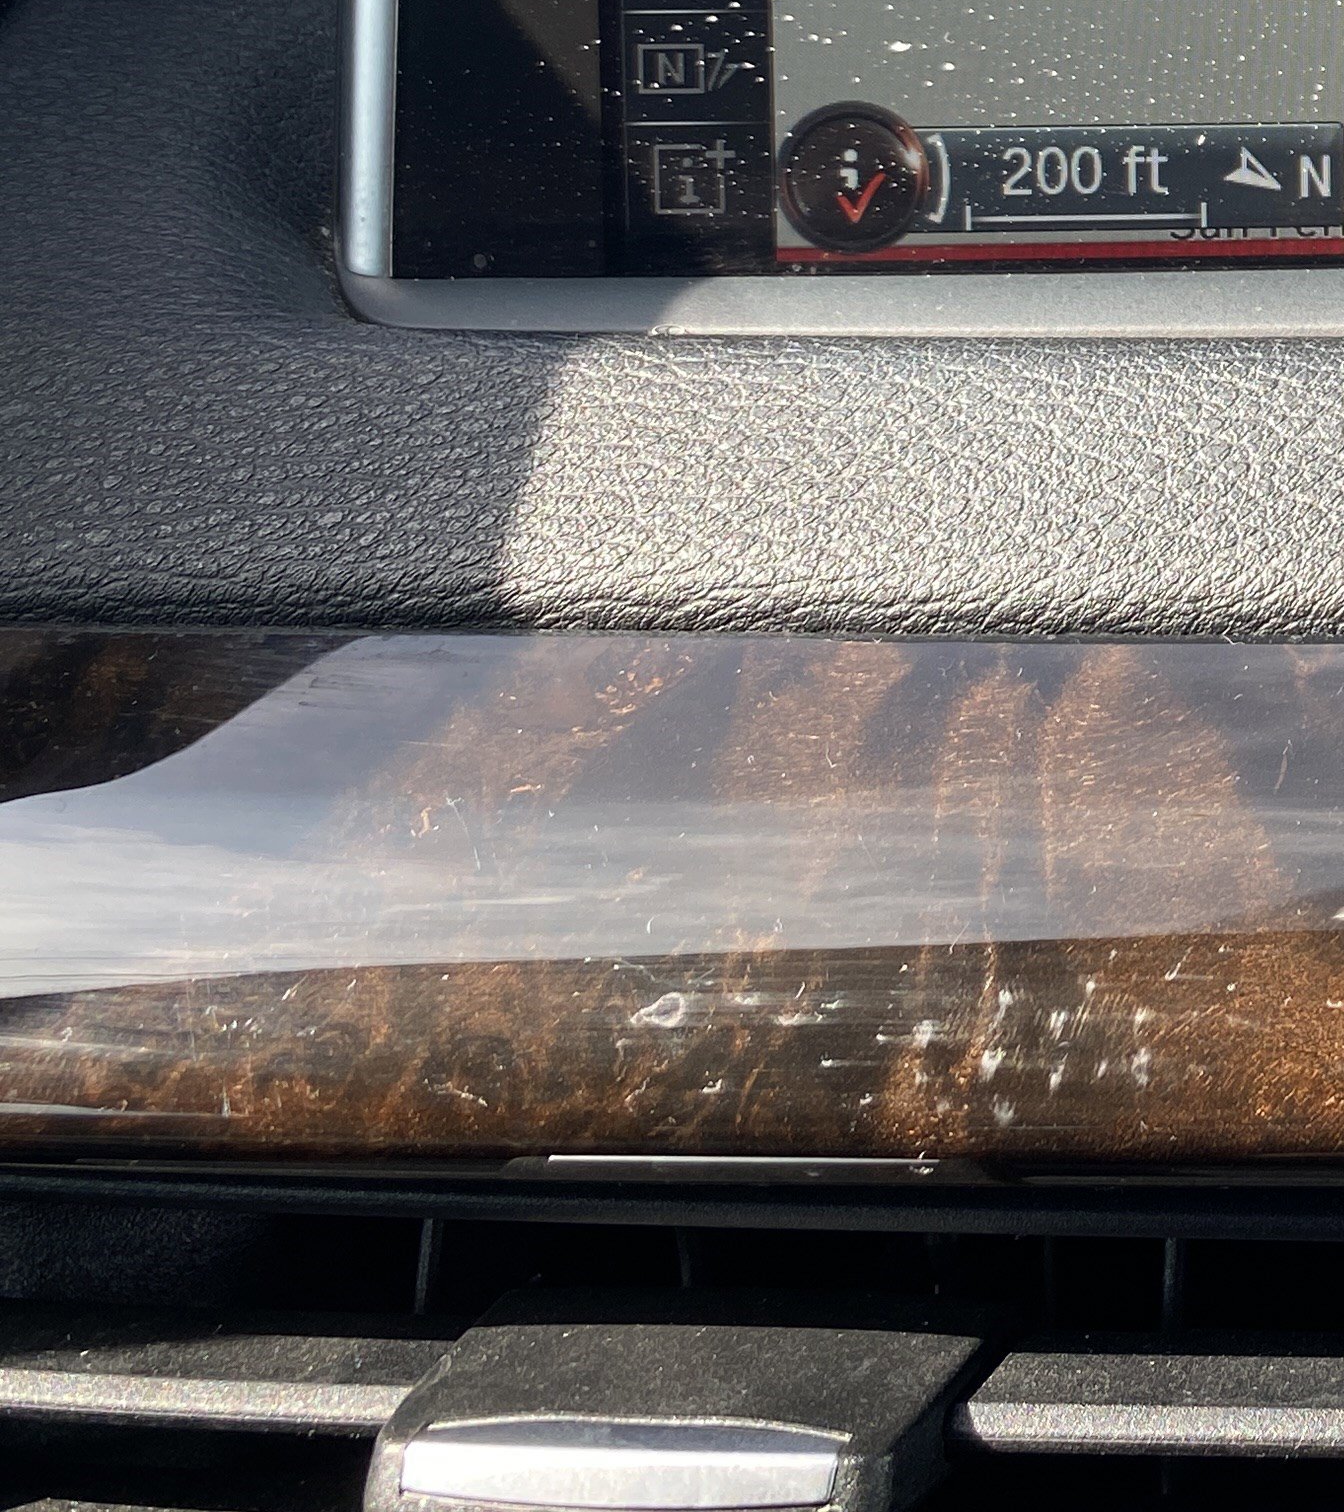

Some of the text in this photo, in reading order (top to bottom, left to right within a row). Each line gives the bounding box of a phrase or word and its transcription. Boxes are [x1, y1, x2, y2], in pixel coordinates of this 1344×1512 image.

[1000, 145, 1169, 196] 200 ft
[1299, 154, 1332, 198] N
